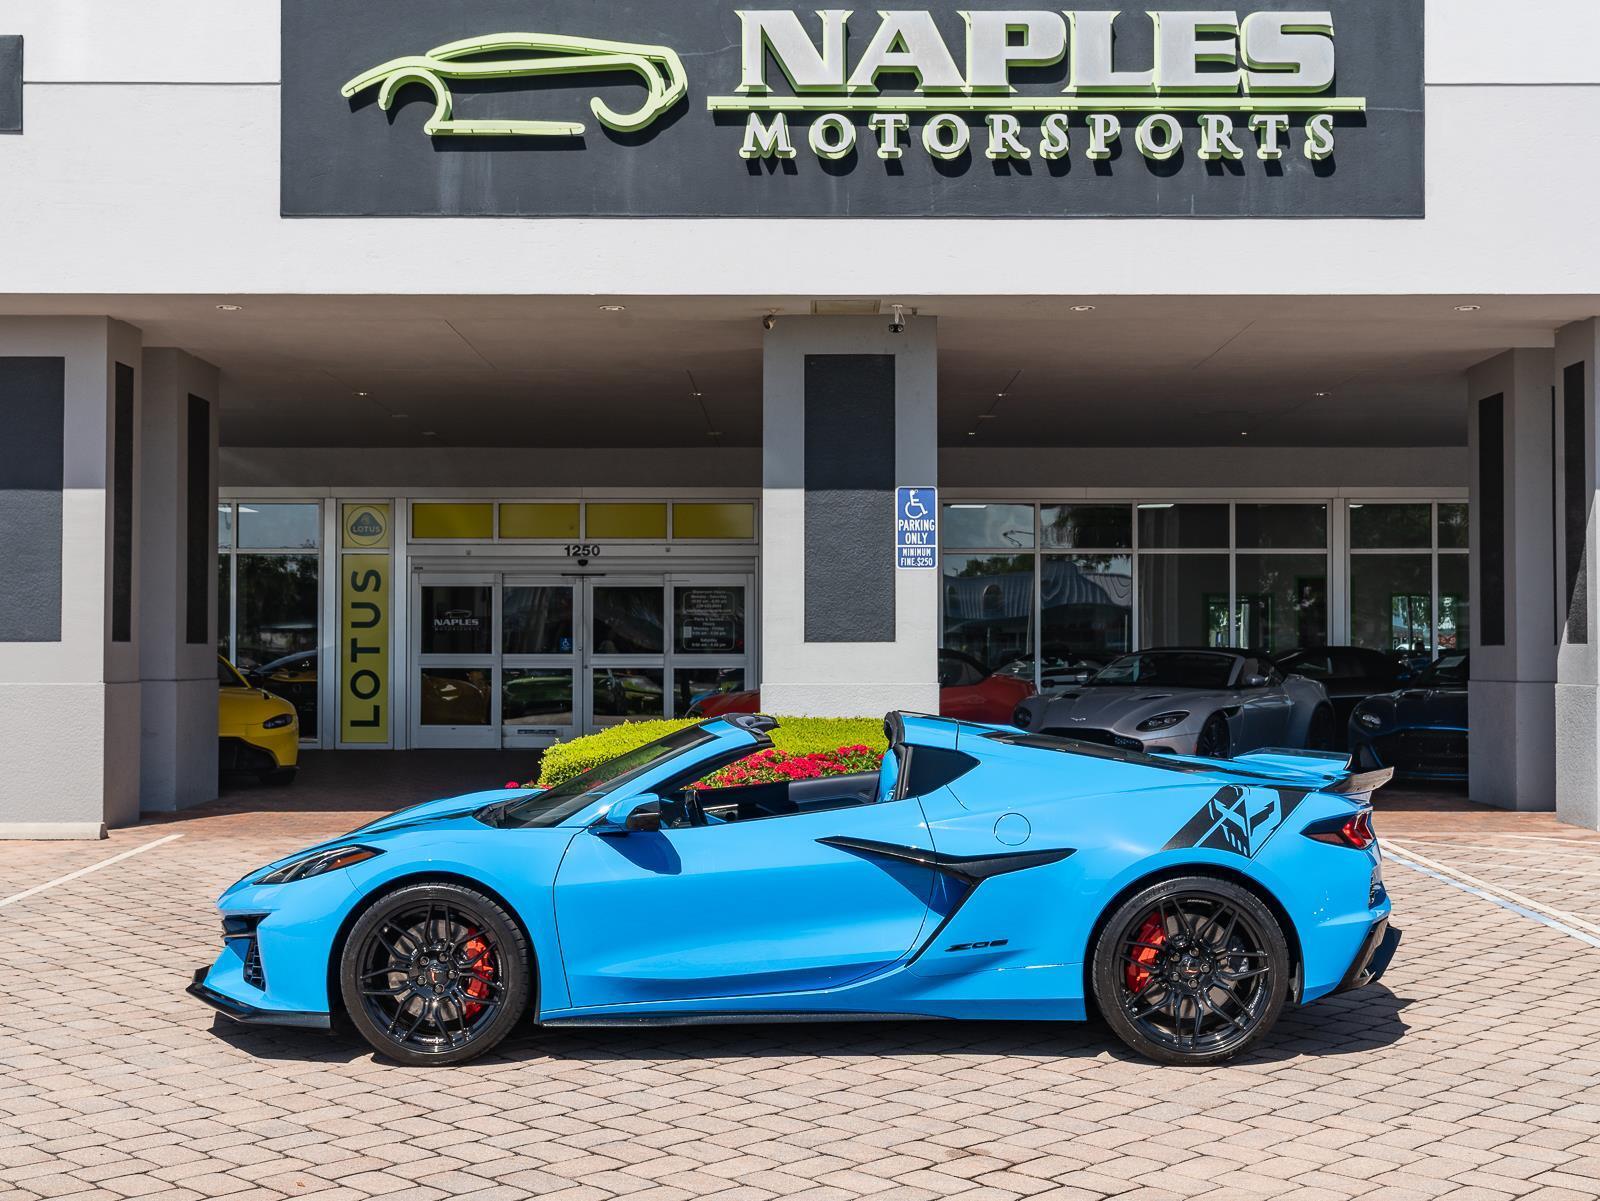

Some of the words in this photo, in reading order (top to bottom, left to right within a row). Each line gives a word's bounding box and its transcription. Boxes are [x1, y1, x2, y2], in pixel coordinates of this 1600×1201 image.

[735, 9, 1336, 94] NAPLES
[739, 112, 1335, 161] MOTORSPORTS
[352, 525, 381, 533] LOTUS
[898, 519, 935, 531] PARKING
[905, 533, 928, 544] ONLY
[564, 544, 601, 557] 1250
[902, 548, 931, 557] MINIMUM
[900, 557, 916, 567] FINE
[916, 557, 933, 567] $250
[433, 618, 480, 626] NAPLES
[350, 569, 381, 727] LOTUS
